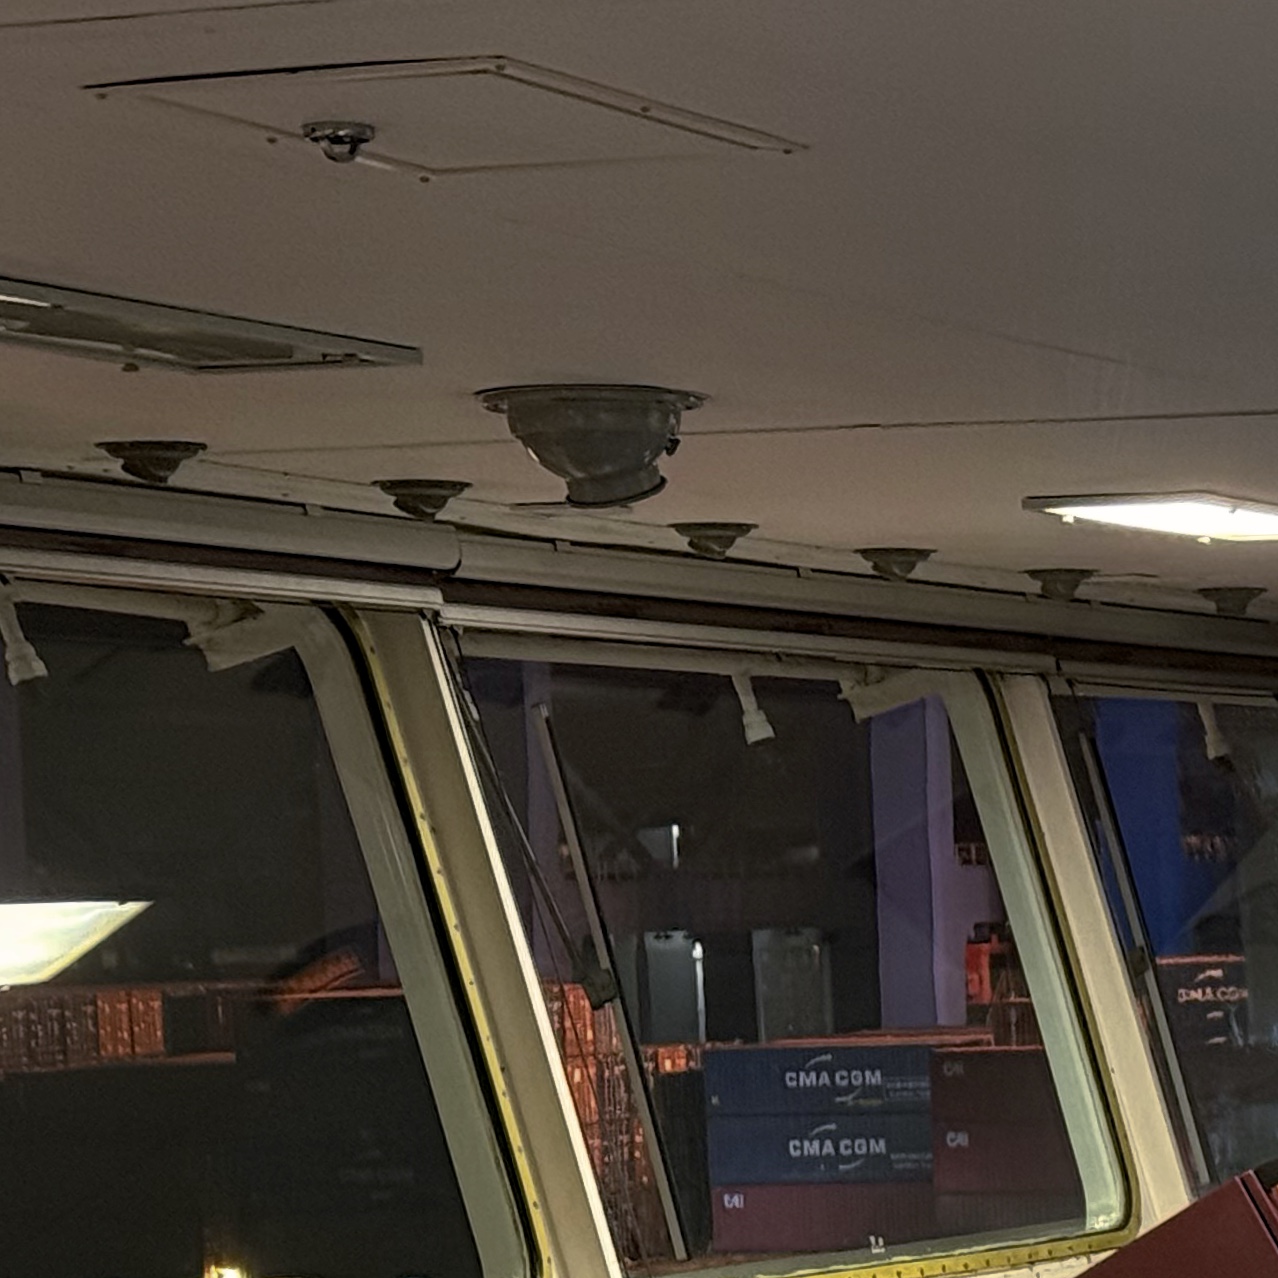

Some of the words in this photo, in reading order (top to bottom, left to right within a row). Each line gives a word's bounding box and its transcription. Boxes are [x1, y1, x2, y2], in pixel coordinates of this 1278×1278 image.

[785, 1070, 831, 1088] CMA
[835, 1069, 883, 1086] CGM
[788, 1138, 836, 1157] CMA
[839, 1137, 887, 1155] CGM
